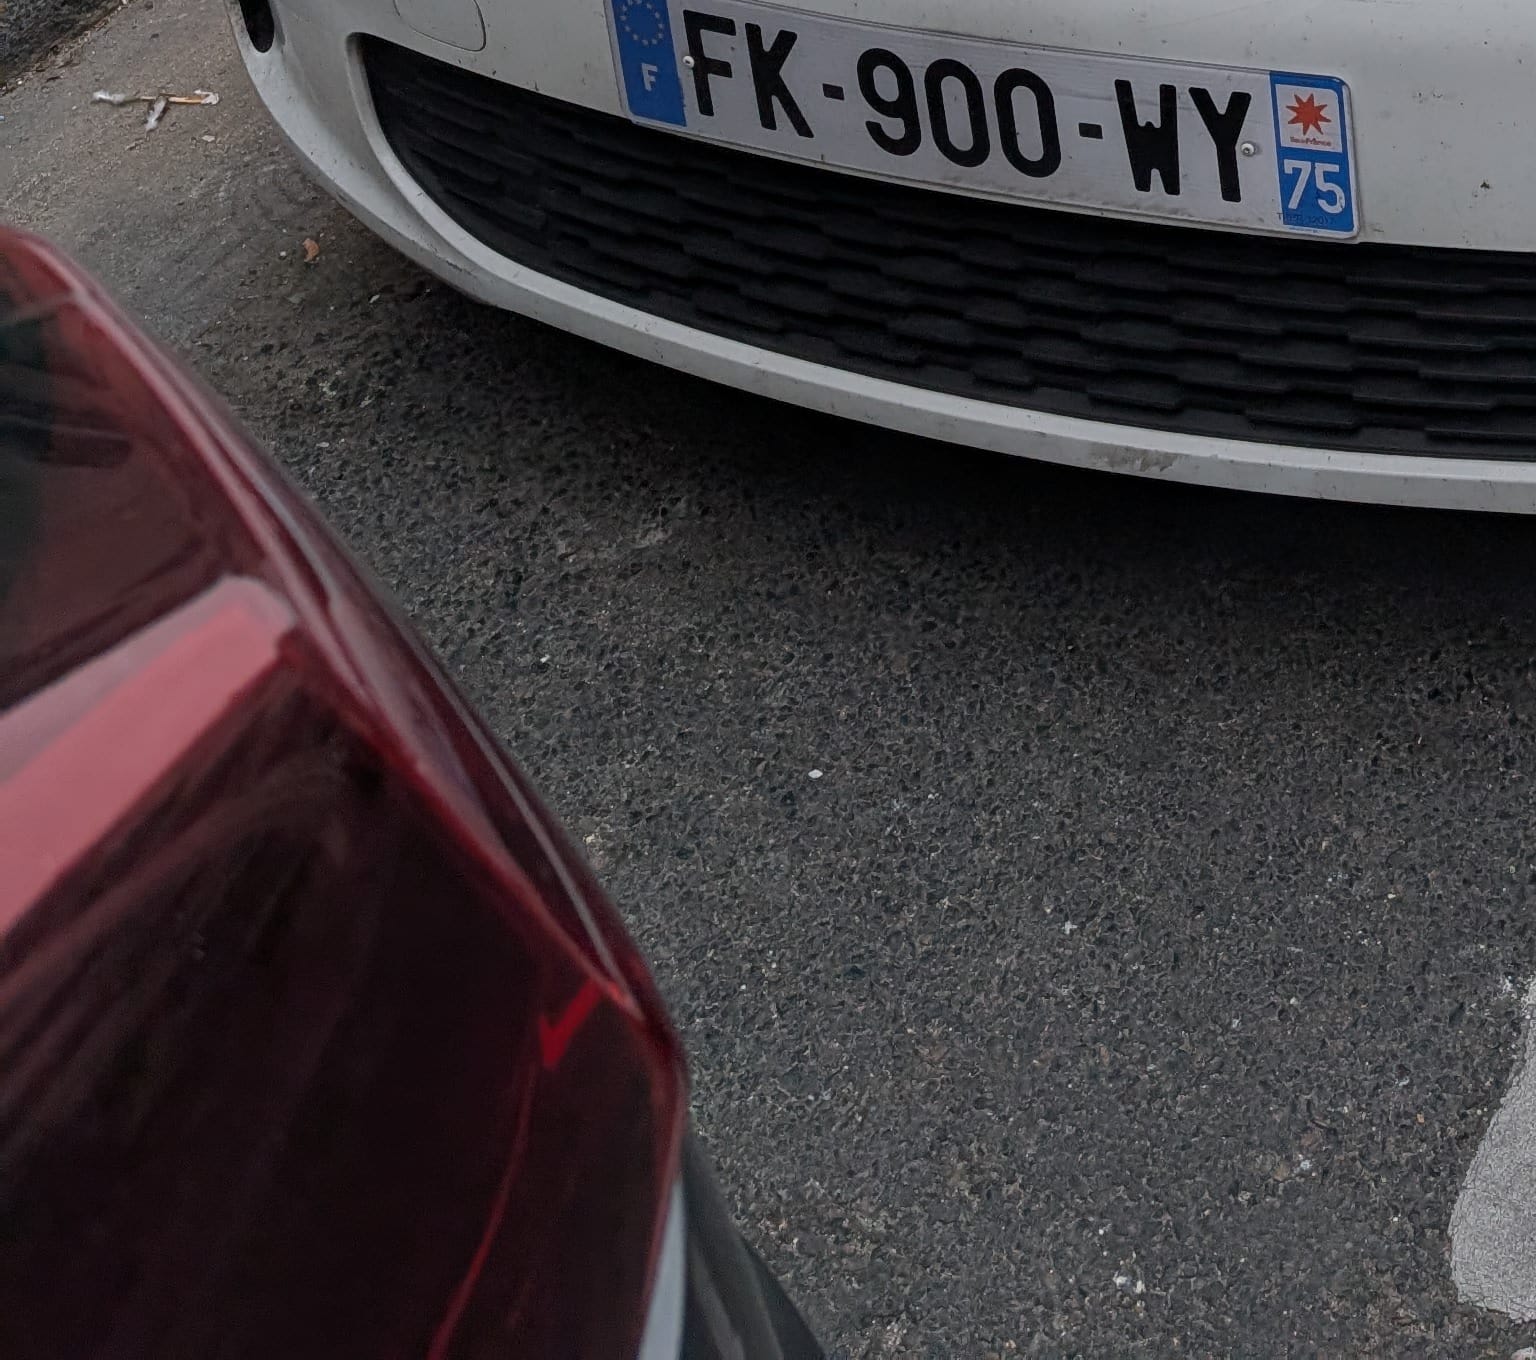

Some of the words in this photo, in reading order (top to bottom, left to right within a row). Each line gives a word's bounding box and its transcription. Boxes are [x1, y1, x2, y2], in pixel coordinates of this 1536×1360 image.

[641, 62, 658, 92] F
[682, 8, 1252, 204] FK-900-WY
[1283, 158, 1346, 214] 75
